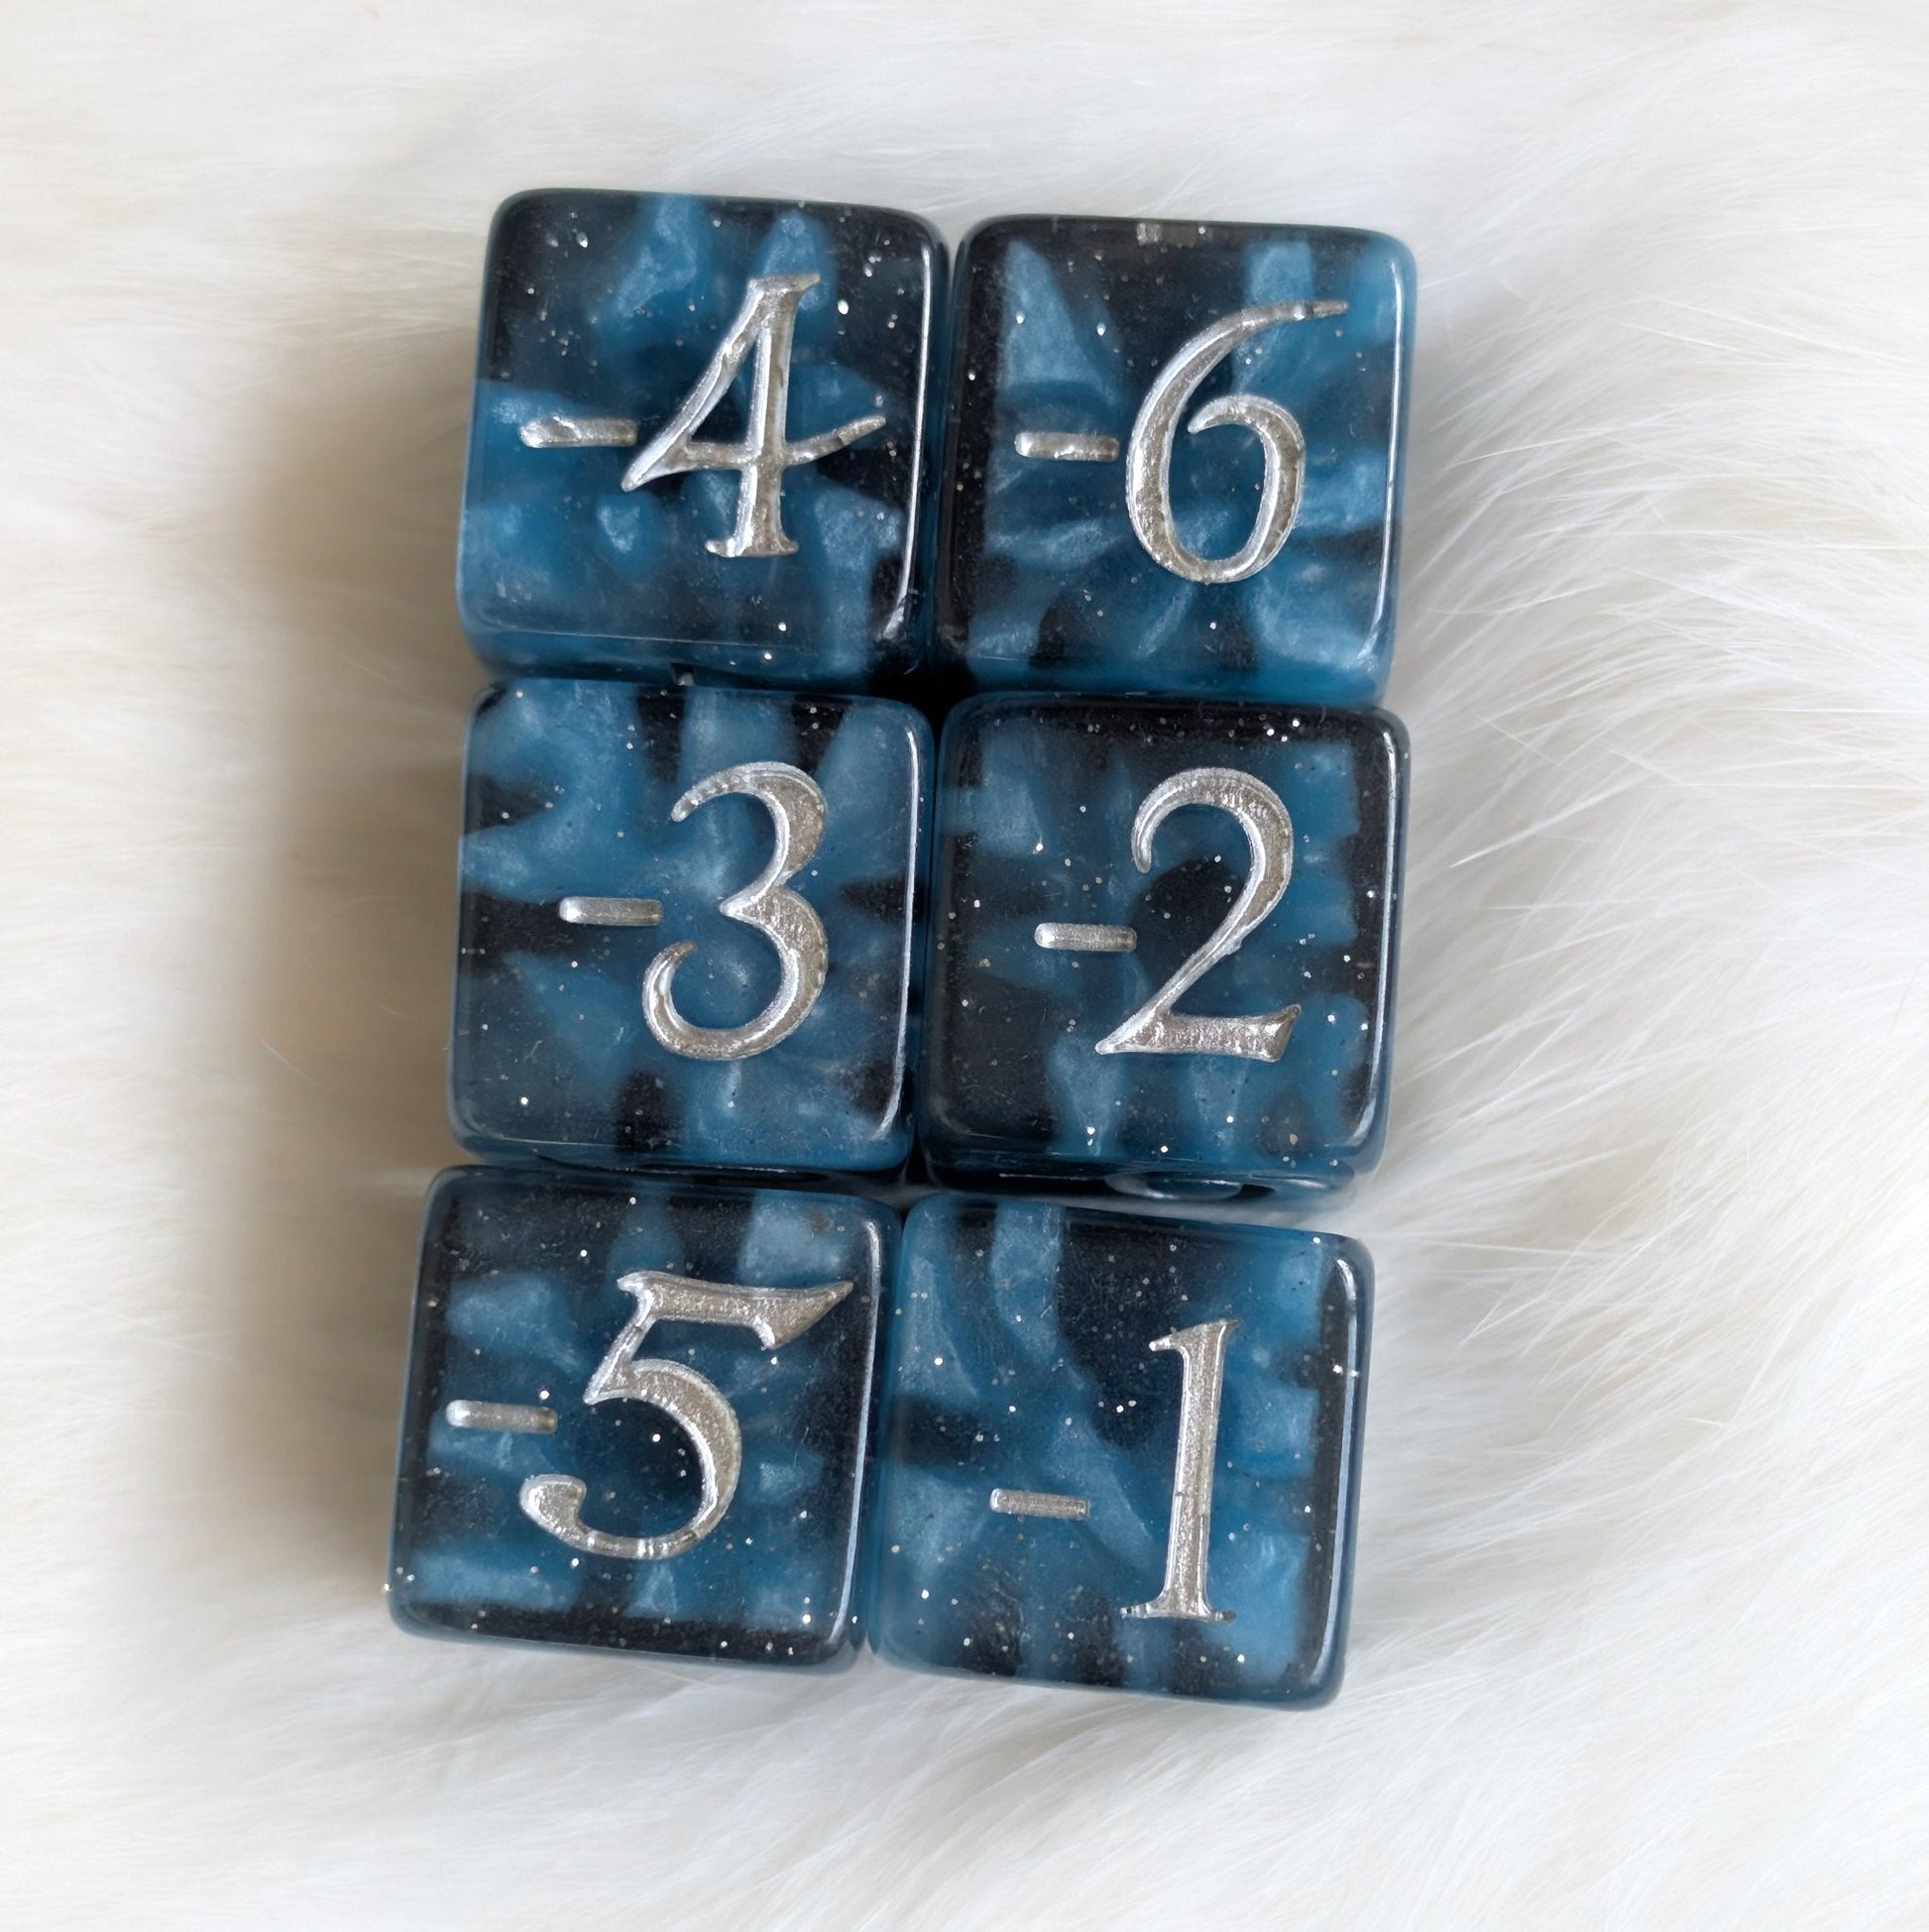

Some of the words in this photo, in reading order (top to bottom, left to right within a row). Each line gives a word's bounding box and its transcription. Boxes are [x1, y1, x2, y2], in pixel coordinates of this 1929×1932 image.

[519, 273, 887, 560] -4
[1014, 298, 1350, 585] -6
[558, 760, 829, 1061] -3
[1033, 766, 1302, 1064] -2
[444, 1271, 854, 1561] -5
[989, 1316, 1237, 1623] -1
